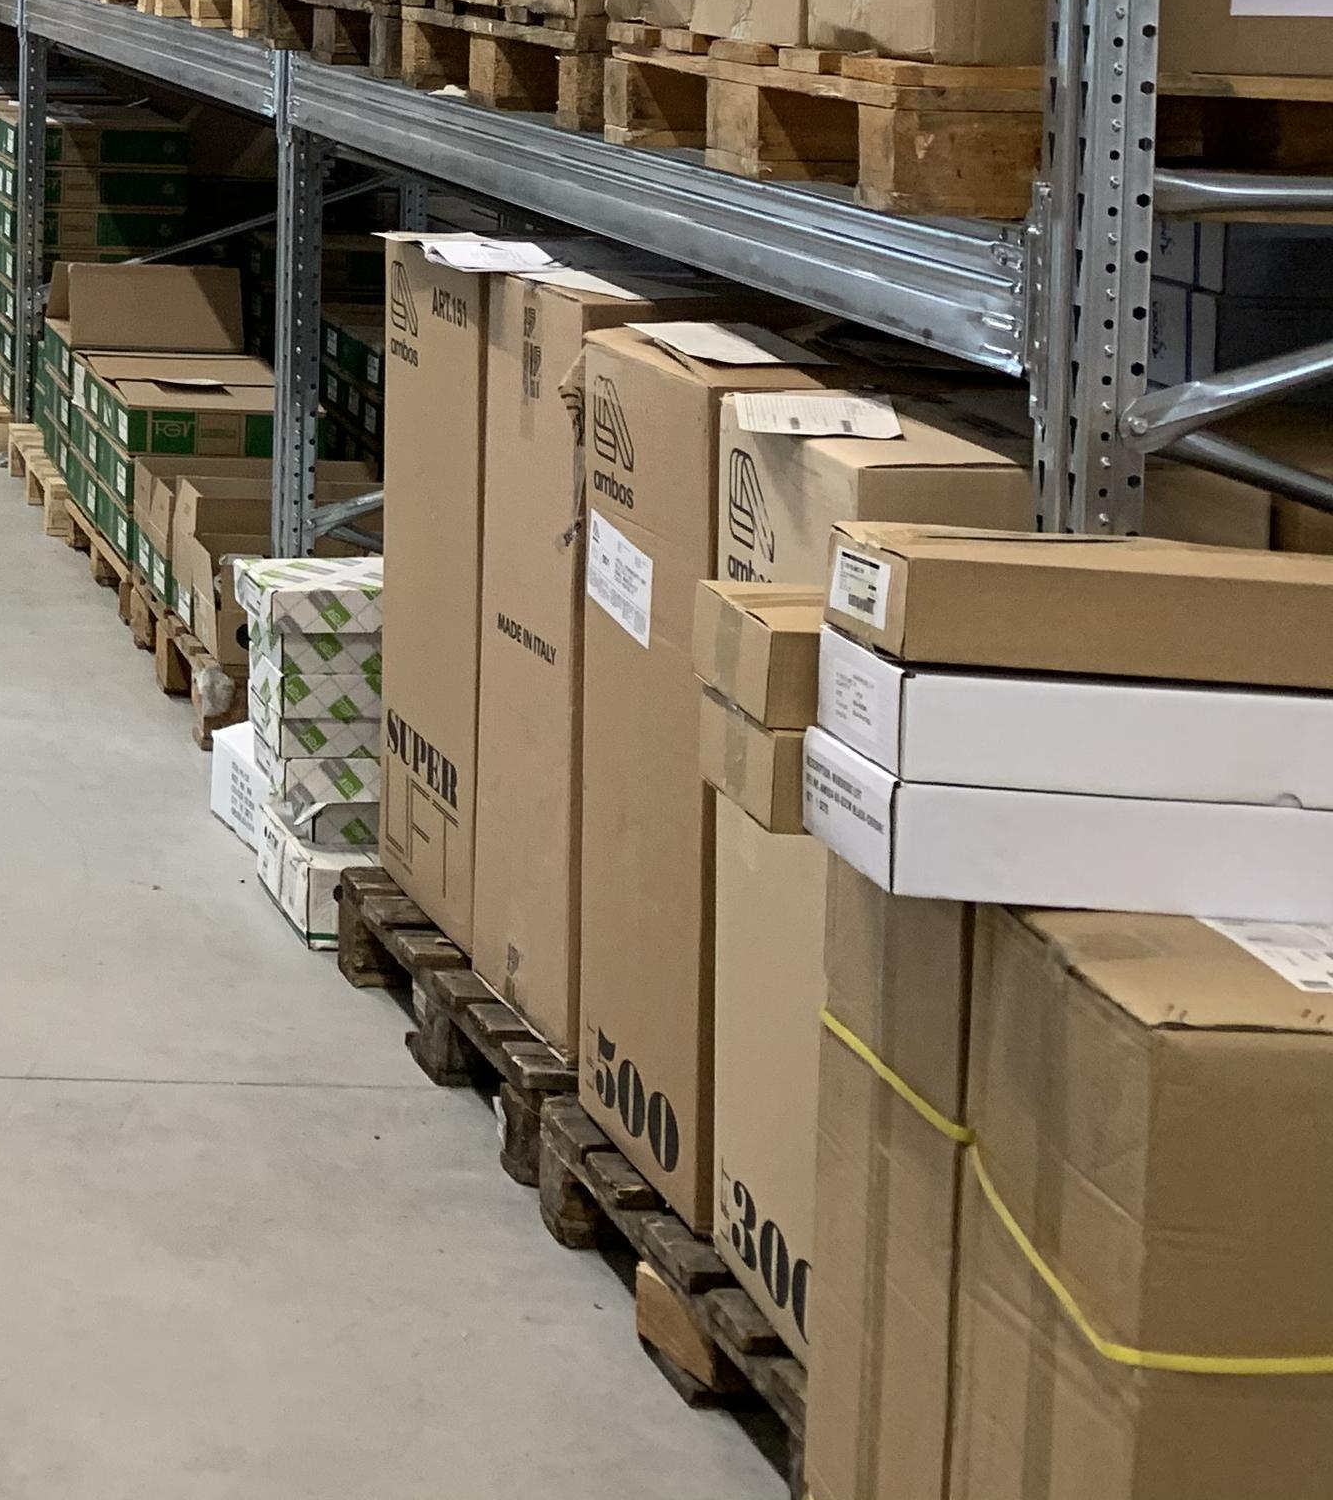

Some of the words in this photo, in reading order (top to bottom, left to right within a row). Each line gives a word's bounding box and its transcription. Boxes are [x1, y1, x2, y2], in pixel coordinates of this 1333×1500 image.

[391, 338, 418, 367] ambos
[594, 469, 634, 509] ambos
[728, 554, 773, 583] amb
[497, 612, 523, 643] MADE
[523, 627, 533, 651] IN
[533, 633, 556, 665] ITALY
[386, 708, 458, 811] SUPER
[595, 1026, 679, 1173] 500
